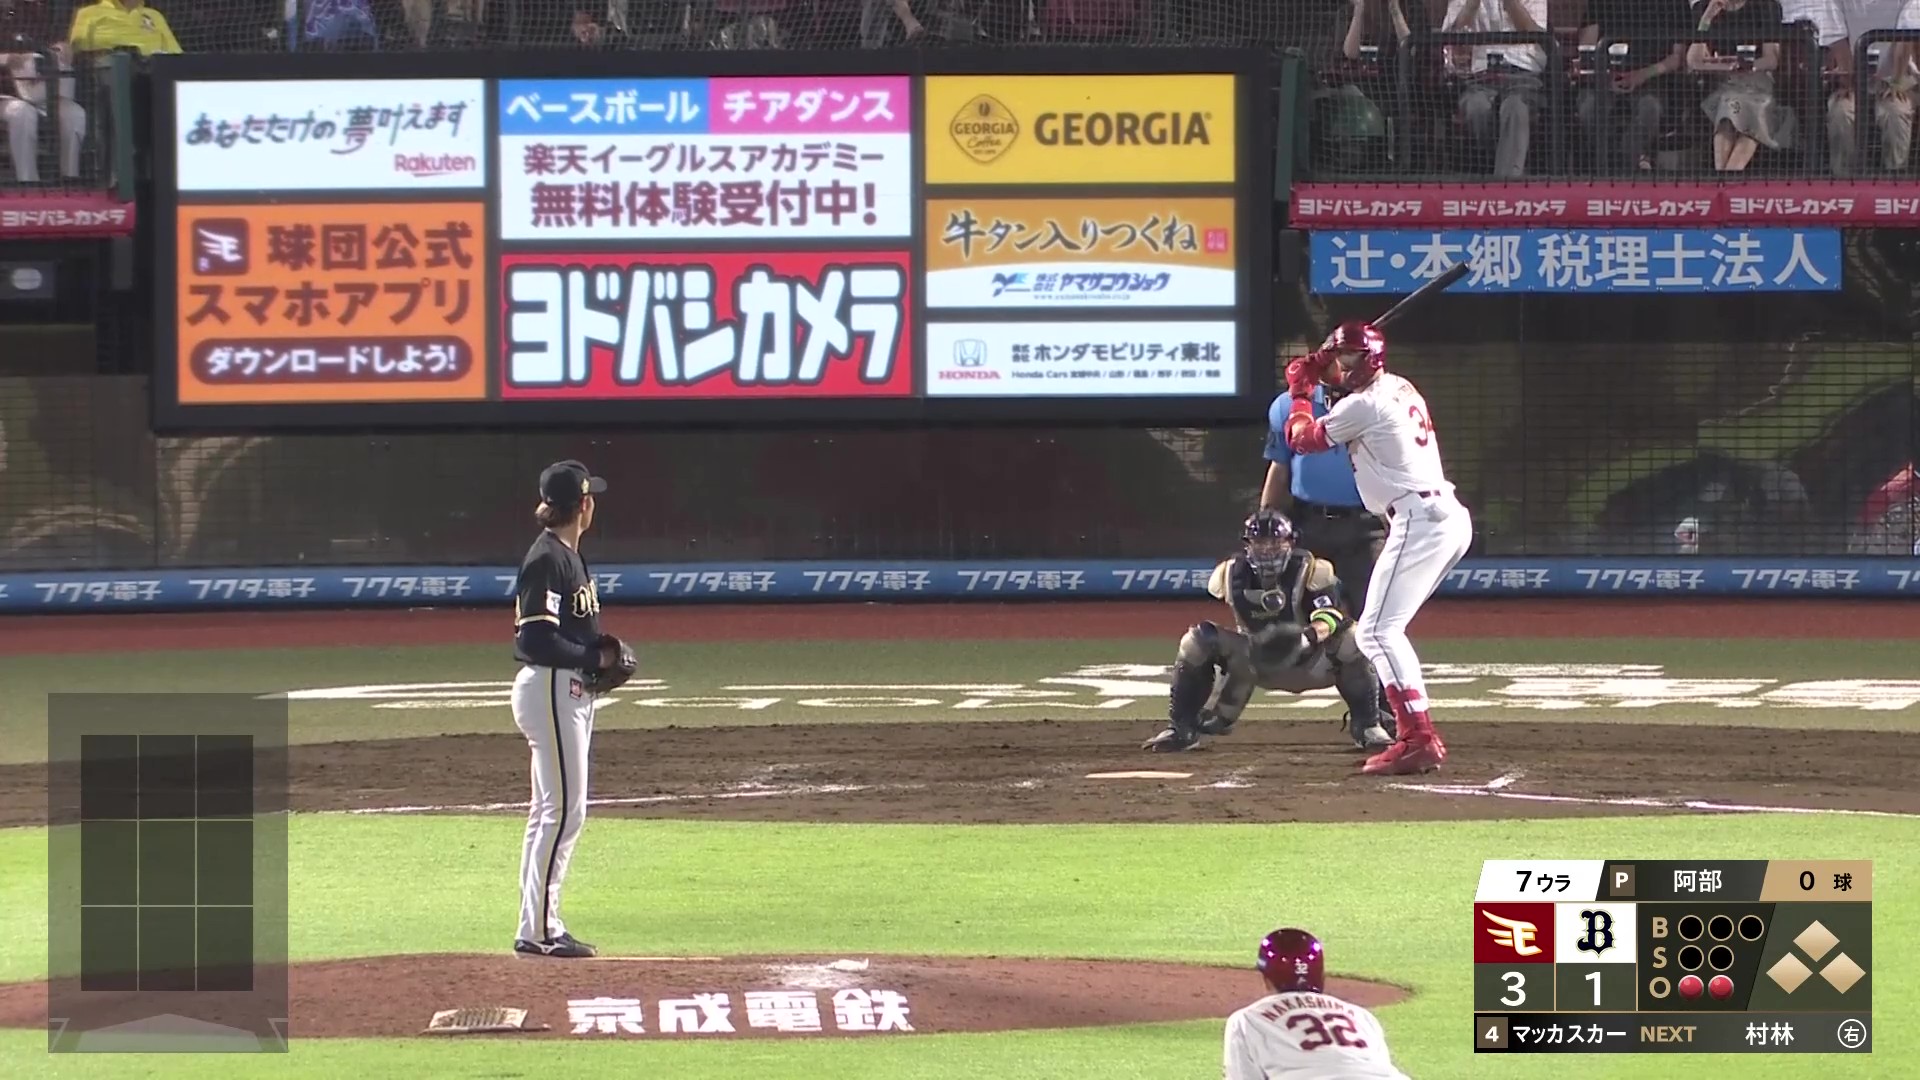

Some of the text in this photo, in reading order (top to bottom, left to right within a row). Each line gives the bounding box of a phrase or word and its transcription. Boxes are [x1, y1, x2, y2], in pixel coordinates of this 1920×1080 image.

[507, 89, 700, 124] ベースボール
[723, 87, 895, 123] チアダンス
[954, 122, 1015, 136] GEORGIA
[1034, 112, 1211, 146] GEORGIA
[394, 153, 476, 178] Rakuten
[524, 141, 884, 176] 楽天イーグルスアカデミー
[531, 180, 877, 228] 無料体験受付中!
[1298, 198, 1423, 217] ヨドバシカメラ
[1442, 199, 1567, 217] ヨドバシカメラ
[1587, 199, 1712, 217] ヨドバシカメラ
[1730, 197, 1855, 215] ヨドバシカメラ
[2, 209, 127, 227] ヨドバシカメラ
[942, 210, 1198, 259] 牛タン入りつくね
[266, 222, 473, 271] 球団公式
[1331, 233, 1828, 288] 辻・本郷 税理士法人
[185, 277, 471, 327] スマホアプリ
[511, 269, 901, 382] ヨドバシカメラ
[207, 344, 457, 376] ダウンロードしよう!
[1034, 342, 1221, 363] ホンダモビリティ東北
[939, 370, 1001, 380] HONDA
[188, 577, 316, 599] フクダ電子
[342, 576, 470, 597] フクダ電子
[649, 571, 776, 592] フクダ電子
[803, 570, 931, 591] フクダ電子
[957, 570, 1085, 590] フクダ電子
[1112, 569, 1212, 590] フクダ電
[1446, 568, 1550, 589] クダ電子
[1575, 568, 1705, 589] フクダ電子
[1731, 568, 1860, 589] フクダ電子
[34, 580, 162, 602] フクダ電子
[1294, 962, 1309, 975] 32
[567, 988, 915, 1033] 京成電鉄
[1285, 1013, 1368, 1051] 32
